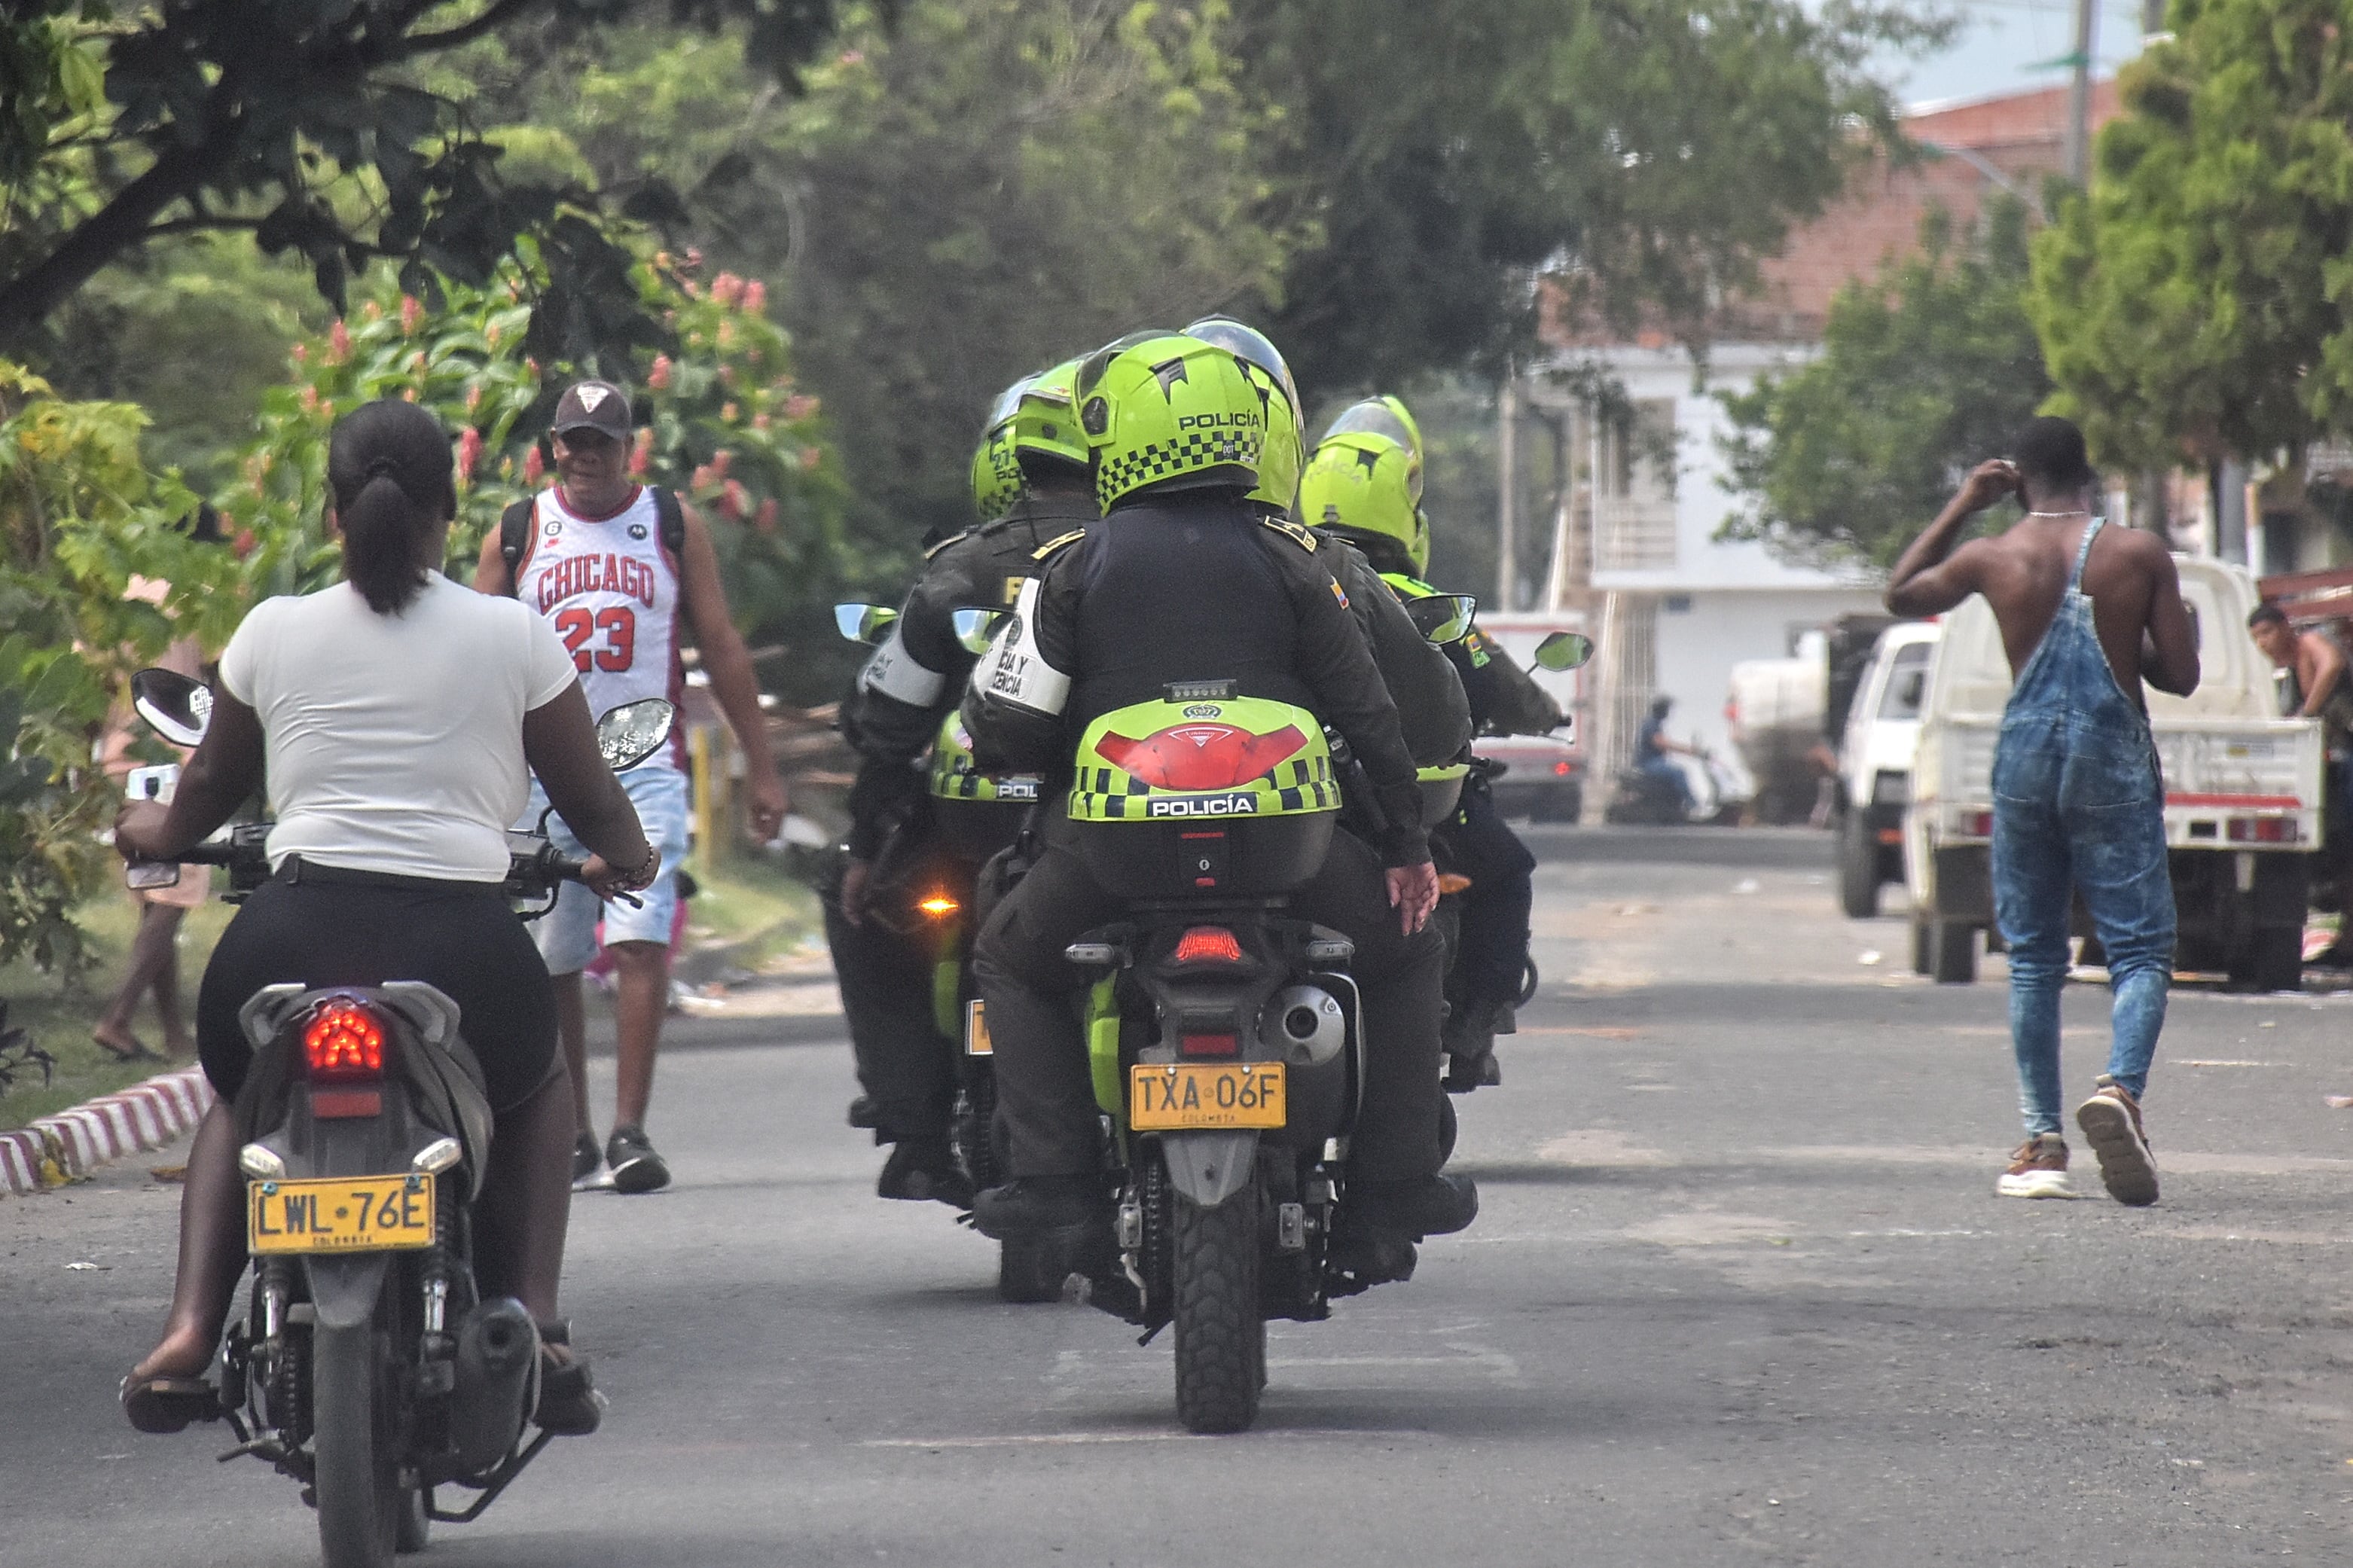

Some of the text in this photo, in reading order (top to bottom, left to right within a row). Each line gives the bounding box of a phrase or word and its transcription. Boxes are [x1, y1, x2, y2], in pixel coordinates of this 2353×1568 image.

[1179, 409, 1260, 431] POLICÍA
[538, 553, 655, 616] CHICAGO
[554, 606, 635, 673] 23
[1018, 656, 1030, 675] Y
[1152, 794, 1254, 816] POLICÍA
